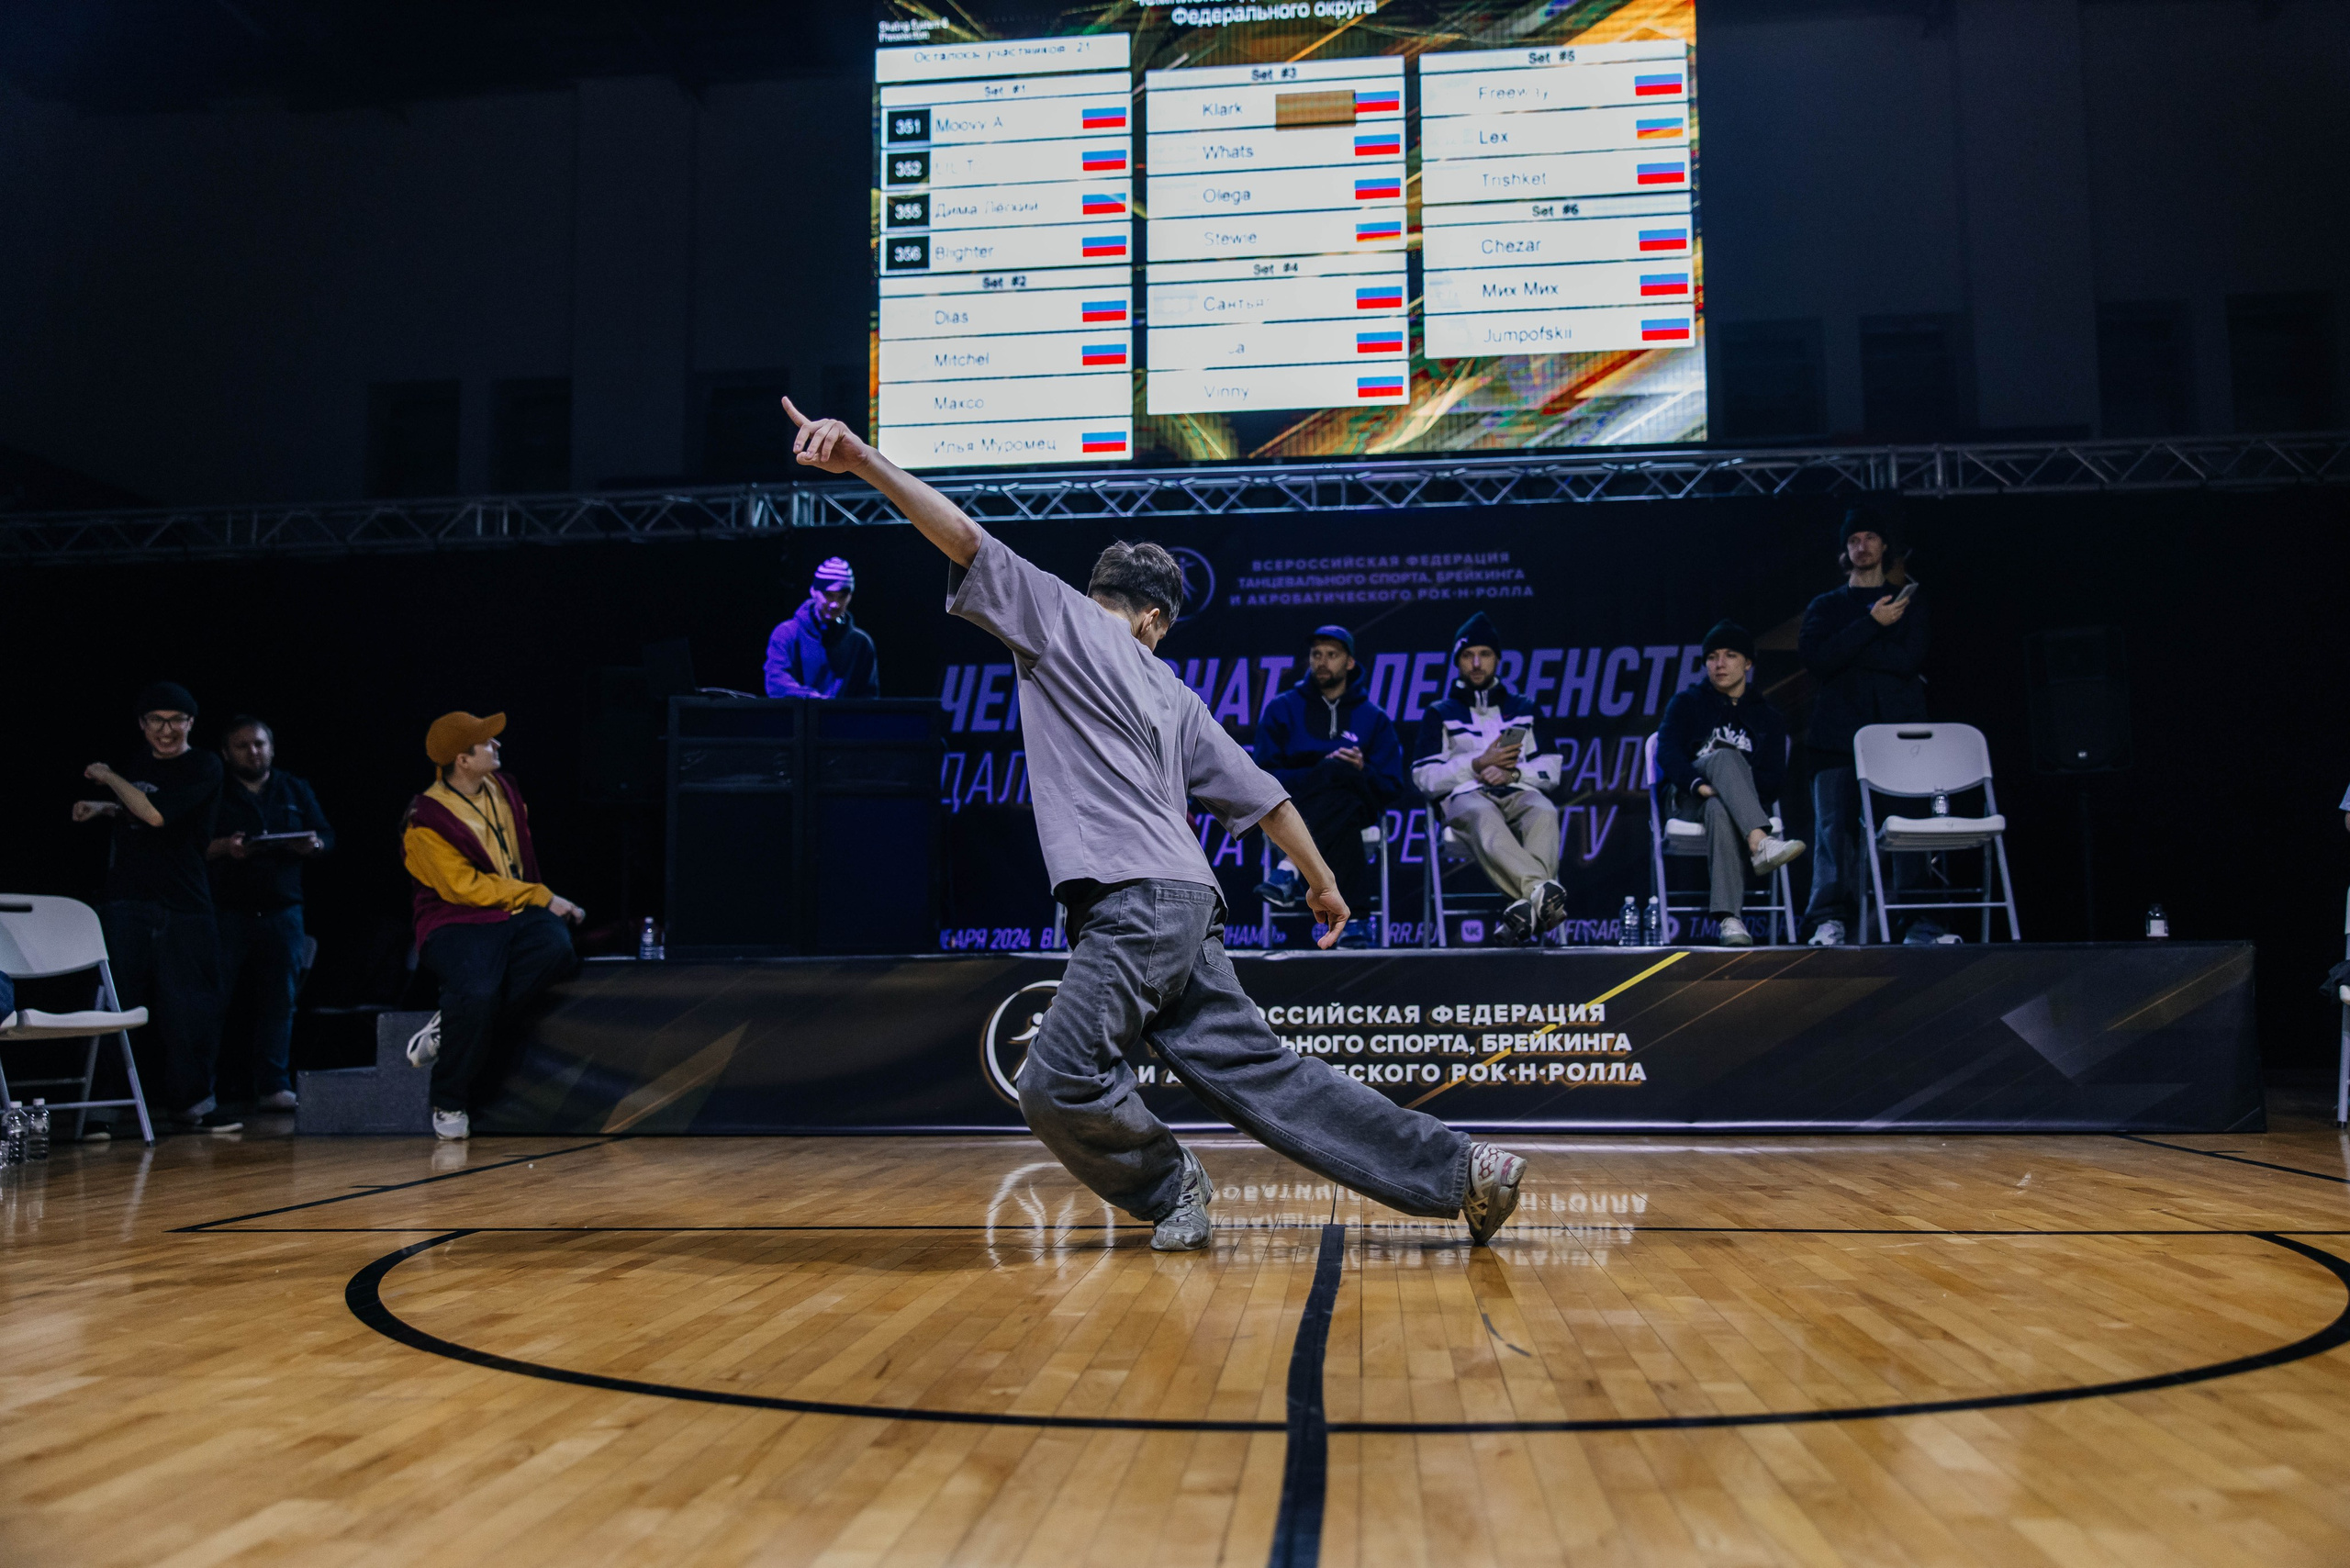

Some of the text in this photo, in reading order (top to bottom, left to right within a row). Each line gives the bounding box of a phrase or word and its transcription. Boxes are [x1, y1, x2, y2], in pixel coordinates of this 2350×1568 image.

[1171, 0, 1377, 27] Федерального округа
[1528, 51, 1550, 64] Set
[1252, 67, 1298, 81] Set #3
[1203, 101, 1243, 117] Klark
[1479, 130, 1509, 145] Lex
[1203, 145, 1255, 160] Whats
[1203, 188, 1252, 206] Olega
[1532, 205, 1555, 218] Set
[1203, 231, 1258, 246] Stewie
[1481, 239, 1541, 254] Chezar
[1253, 262, 1299, 275] Set #4
[981, 275, 1027, 289] Set #2
[934, 309, 969, 325] Dias
[934, 353, 990, 367] Mitchel
[1203, 385, 1249, 401] Vinny
[1251, 551, 1511, 572] ВСЕРОССИЙСКАЯ ФЕДЕРАЦИЯ
[1237, 573, 1366, 589] ТАНЦЕВАЛЬНОГО
[1436, 567, 1526, 583] БРЕЙКИНГА
[1229, 594, 1241, 607] И
[1247, 589, 1412, 606] АКРОБАТИЧЕСКОГО
[990, 927, 1031, 949] 2024
[1431, 1003, 1606, 1026] ФЕДЕРАЦИЯ
[1370, 1034, 1475, 1055] СПОРТА,
[1482, 1029, 1632, 1053] БРЕЙКИНГА
[1137, 1065, 1156, 1084] И
